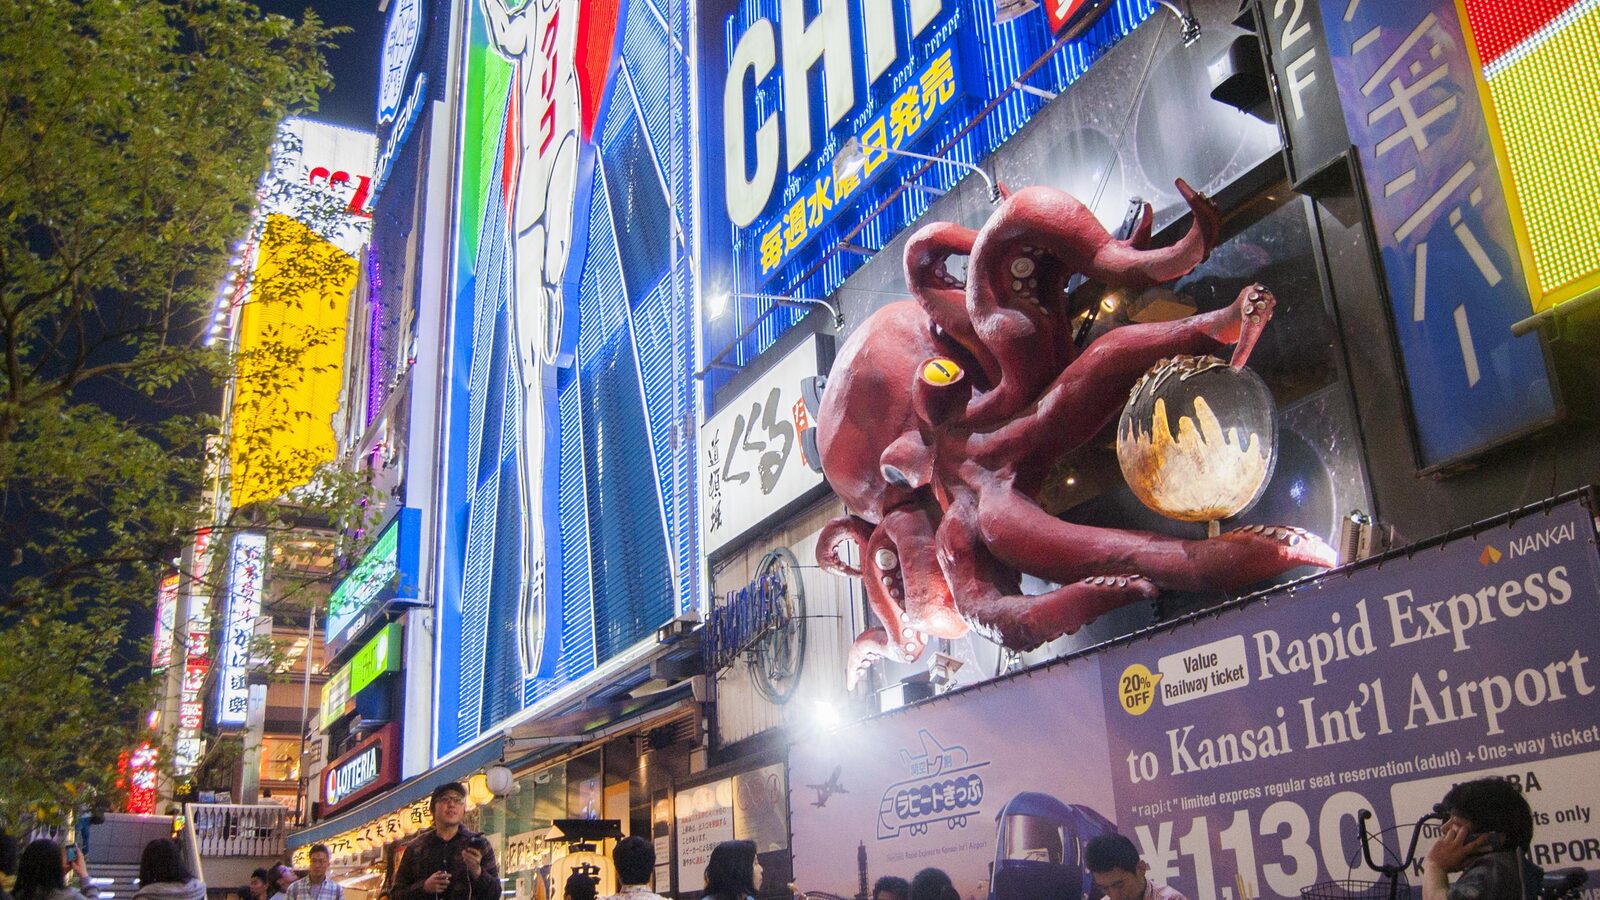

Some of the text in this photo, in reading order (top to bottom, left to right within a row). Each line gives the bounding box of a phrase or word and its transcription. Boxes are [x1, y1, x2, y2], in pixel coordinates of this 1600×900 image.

[1273, 0, 1316, 121] 2F
[723, 0, 943, 228] CH
[1342, 0, 1502, 389] ンギンバー
[722, 387, 795, 496] くくる
[1508, 522, 1575, 559] NANKAI
[1183, 653, 1218, 673] Value
[1252, 565, 1573, 686] Rapid Express
[1122, 674, 1151, 694] 20%
[1126, 691, 1150, 708] OFF
[1126, 749, 1159, 784] to
[1165, 706, 1293, 776] Kansai
[1403, 649, 1596, 737] Airport
[1165, 664, 1245, 699] Railway ticket
[336, 747, 377, 796] LOTTERIA
[1181, 791, 1217, 811] limited
[1219, 786, 1262, 805] express
[1264, 777, 1306, 797] regular
[1309, 770, 1336, 790] seat
[1339, 756, 1413, 784] reservation
[1415, 749, 1461, 773] (adult)
[1465, 753, 1476, 765] +
[1477, 737, 1545, 762] One-way
[1550, 724, 1600, 749] ticket
[1135, 791, 1385, 900] ¥1,130
[1555, 805, 1591, 824] only
